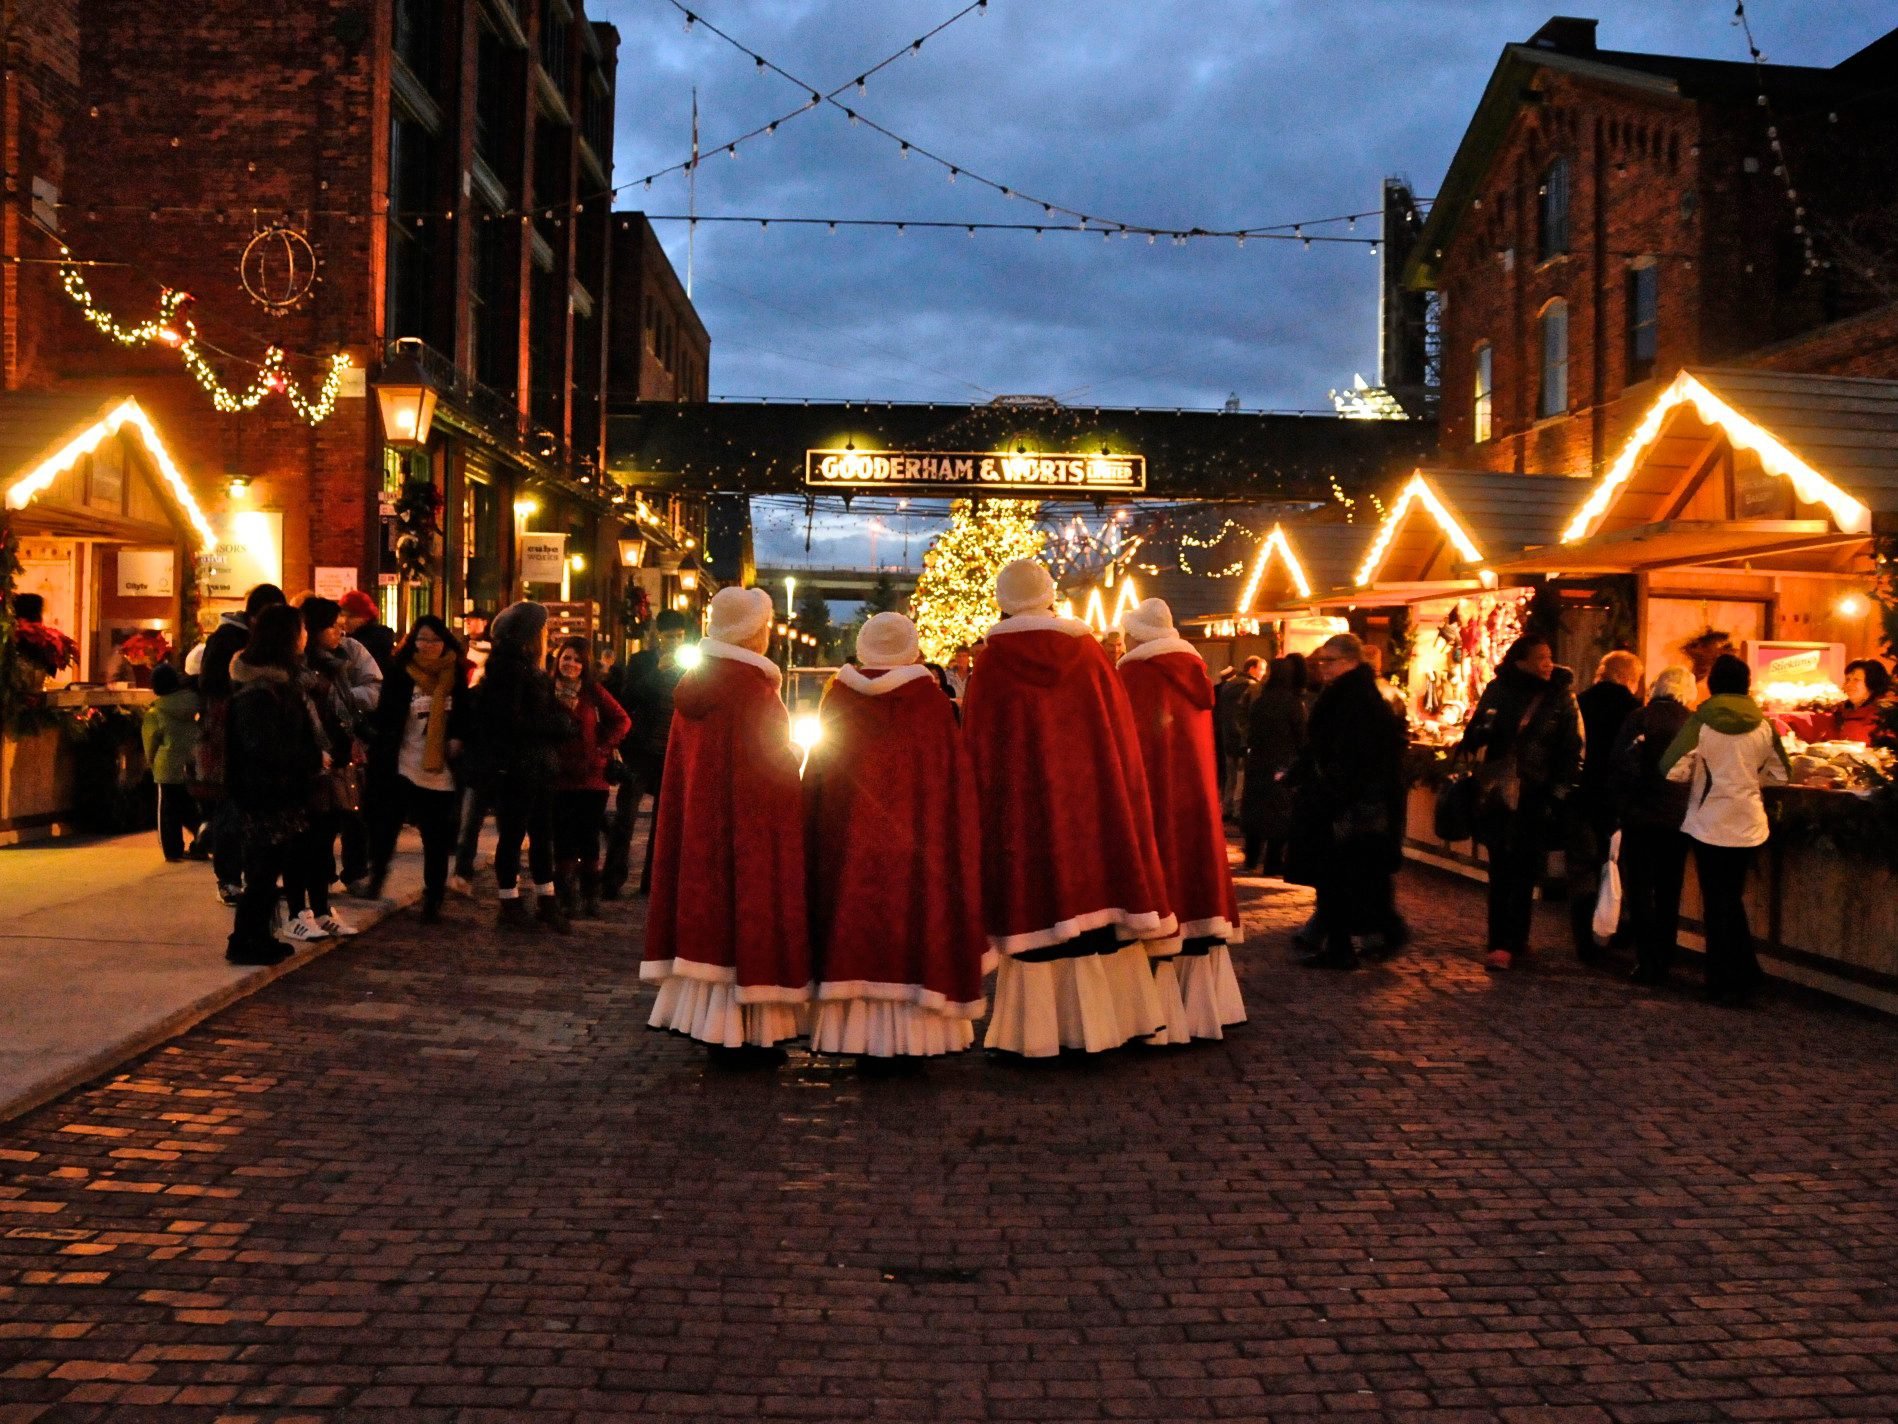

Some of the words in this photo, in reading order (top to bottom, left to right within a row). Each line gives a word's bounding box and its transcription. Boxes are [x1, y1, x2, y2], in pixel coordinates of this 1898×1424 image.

[821, 455, 973, 481] GOODERHAM
[980, 458, 1000, 482] &
[1001, 459, 1085, 483] WORTS
